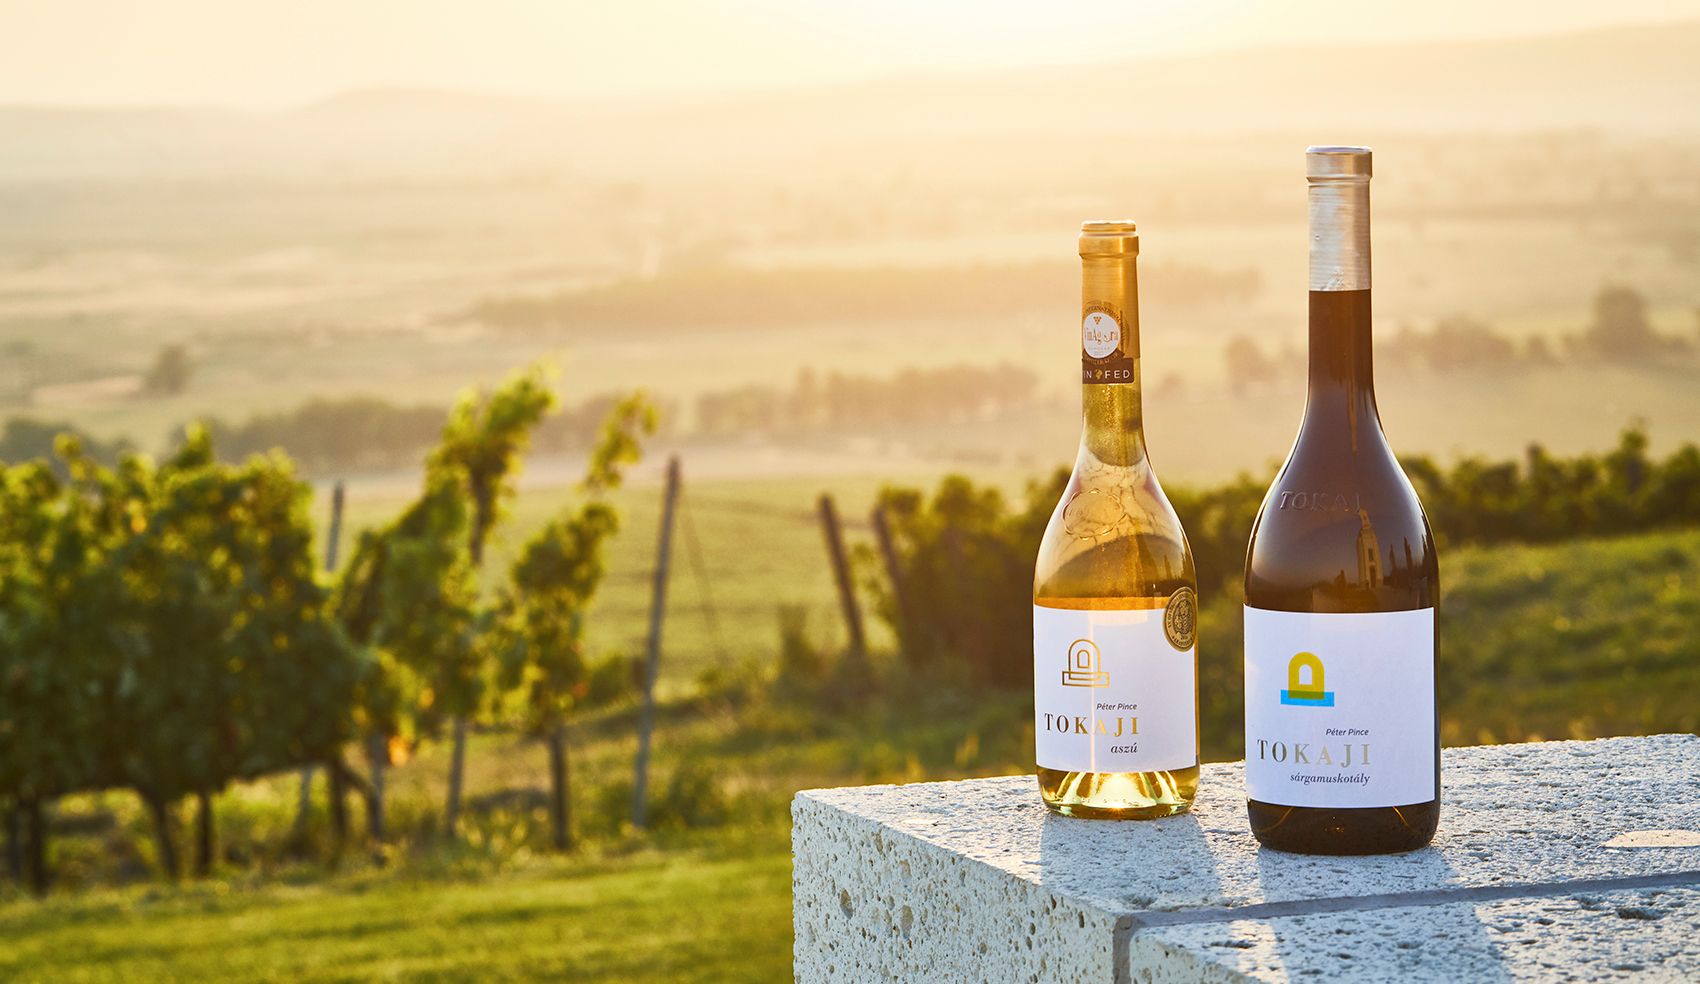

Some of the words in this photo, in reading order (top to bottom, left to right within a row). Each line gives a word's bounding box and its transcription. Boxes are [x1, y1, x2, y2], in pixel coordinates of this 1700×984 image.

[1044, 713, 1139, 737] TOKAJI
[1325, 728, 1346, 736] Péter
[1348, 728, 1369, 736] Pince
[1110, 742, 1138, 753] aszú
[1257, 739, 1371, 768] TOKAJI
[1290, 772, 1371, 786] sárgamuskotály
